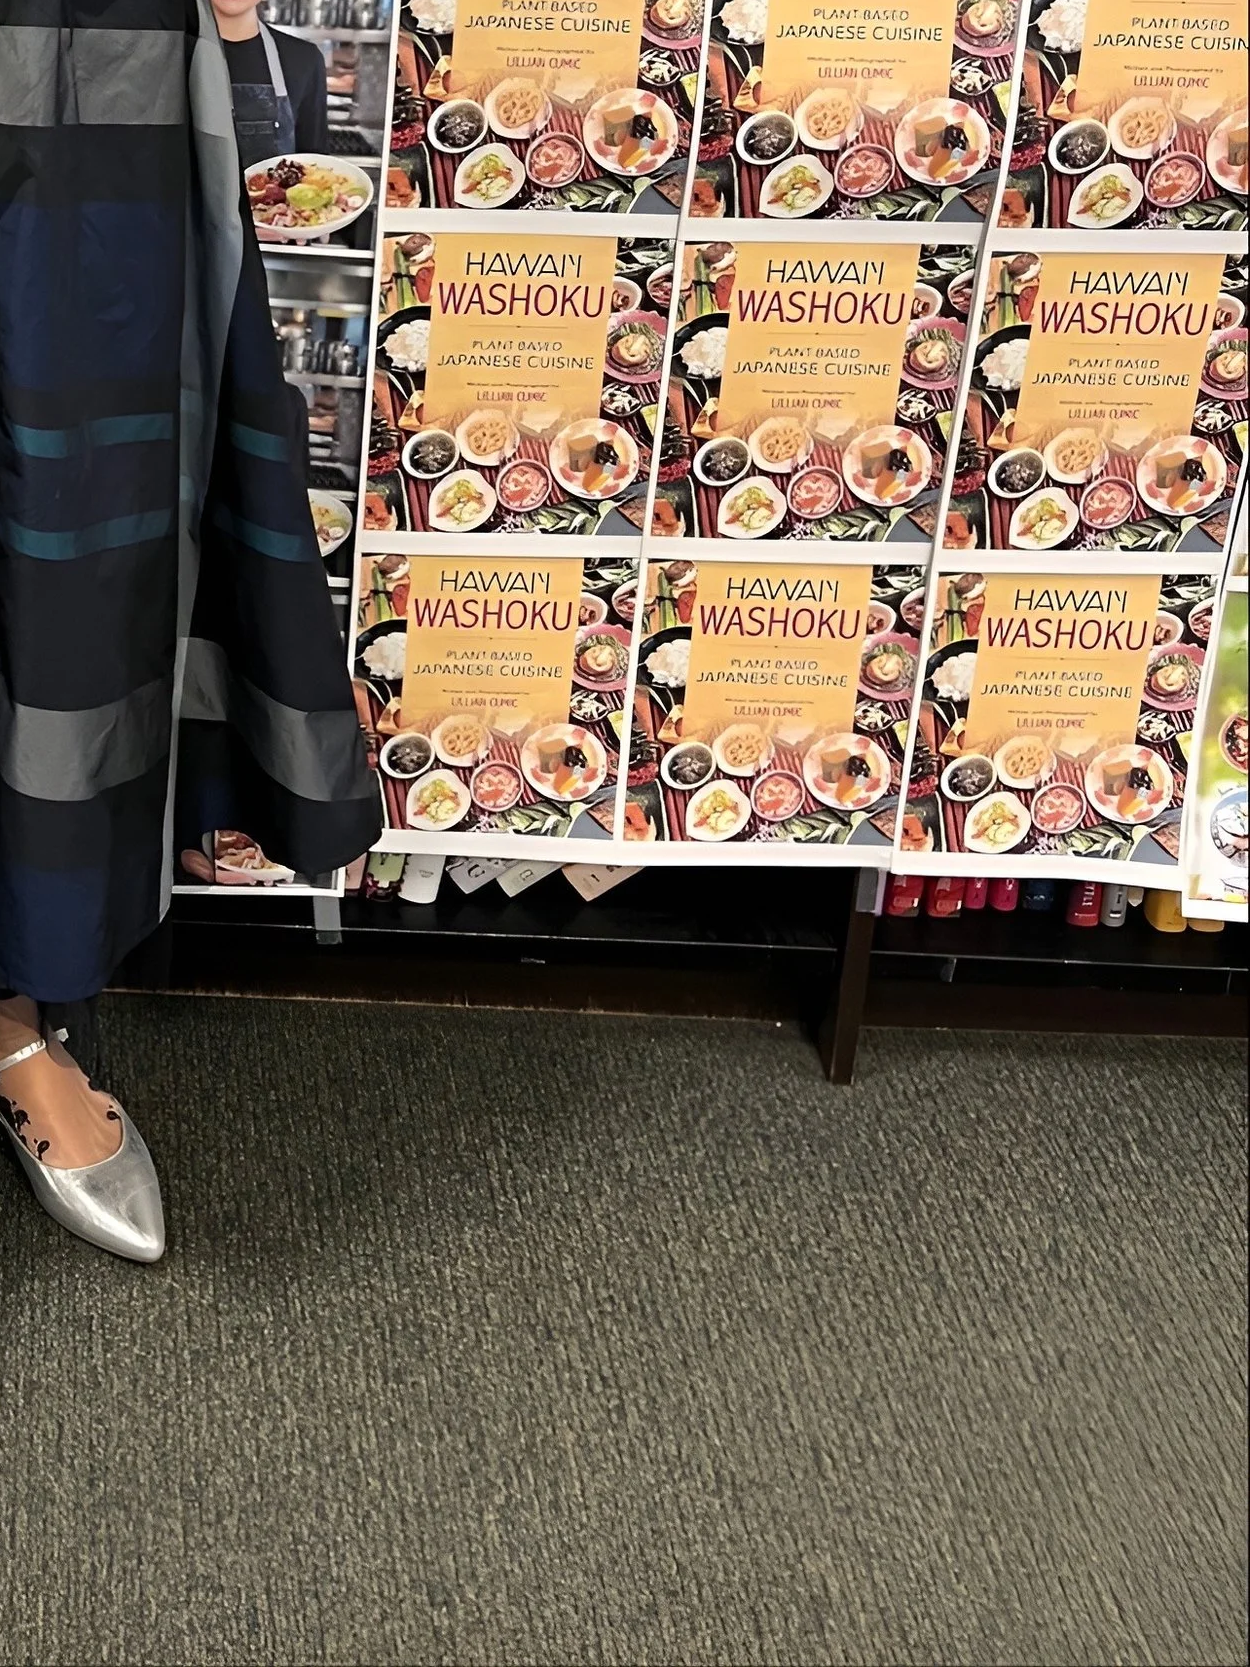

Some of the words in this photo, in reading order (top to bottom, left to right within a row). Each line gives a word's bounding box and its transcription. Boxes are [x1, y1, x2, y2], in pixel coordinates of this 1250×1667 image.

[464, 16, 554, 30] JAPANESE
[560, 18, 630, 34] CUISINE
[776, 24, 866, 40] JAPANESE
[872, 26, 942, 42] CUISINE
[1092, 34, 1184, 50] JAPANESE
[438, 282, 604, 318] WASHOKU
[738, 290, 906, 326] WASHOKU
[1042, 302, 1208, 336] WASHOKU
[438, 354, 520, 368] JAPANESE
[528, 356, 594, 370] CUISINE
[732, 360, 818, 376] JAPANESE
[824, 362, 890, 376] CUISINE
[1032, 372, 1116, 386] JAPANESE
[1122, 374, 1188, 386] CUISINE
[414, 598, 572, 632] WASHOKU
[700, 604, 860, 640] WASHOKU
[988, 618, 1148, 650] WASHOKU
[412, 664, 494, 676] JAPANESE
[500, 664, 562, 678] CUISINE
[696, 672, 776, 684] JAPANESE
[784, 674, 848, 688] CUISINE
[980, 684, 1062, 696] JAPANESE
[1068, 686, 1132, 698] CUISINE
